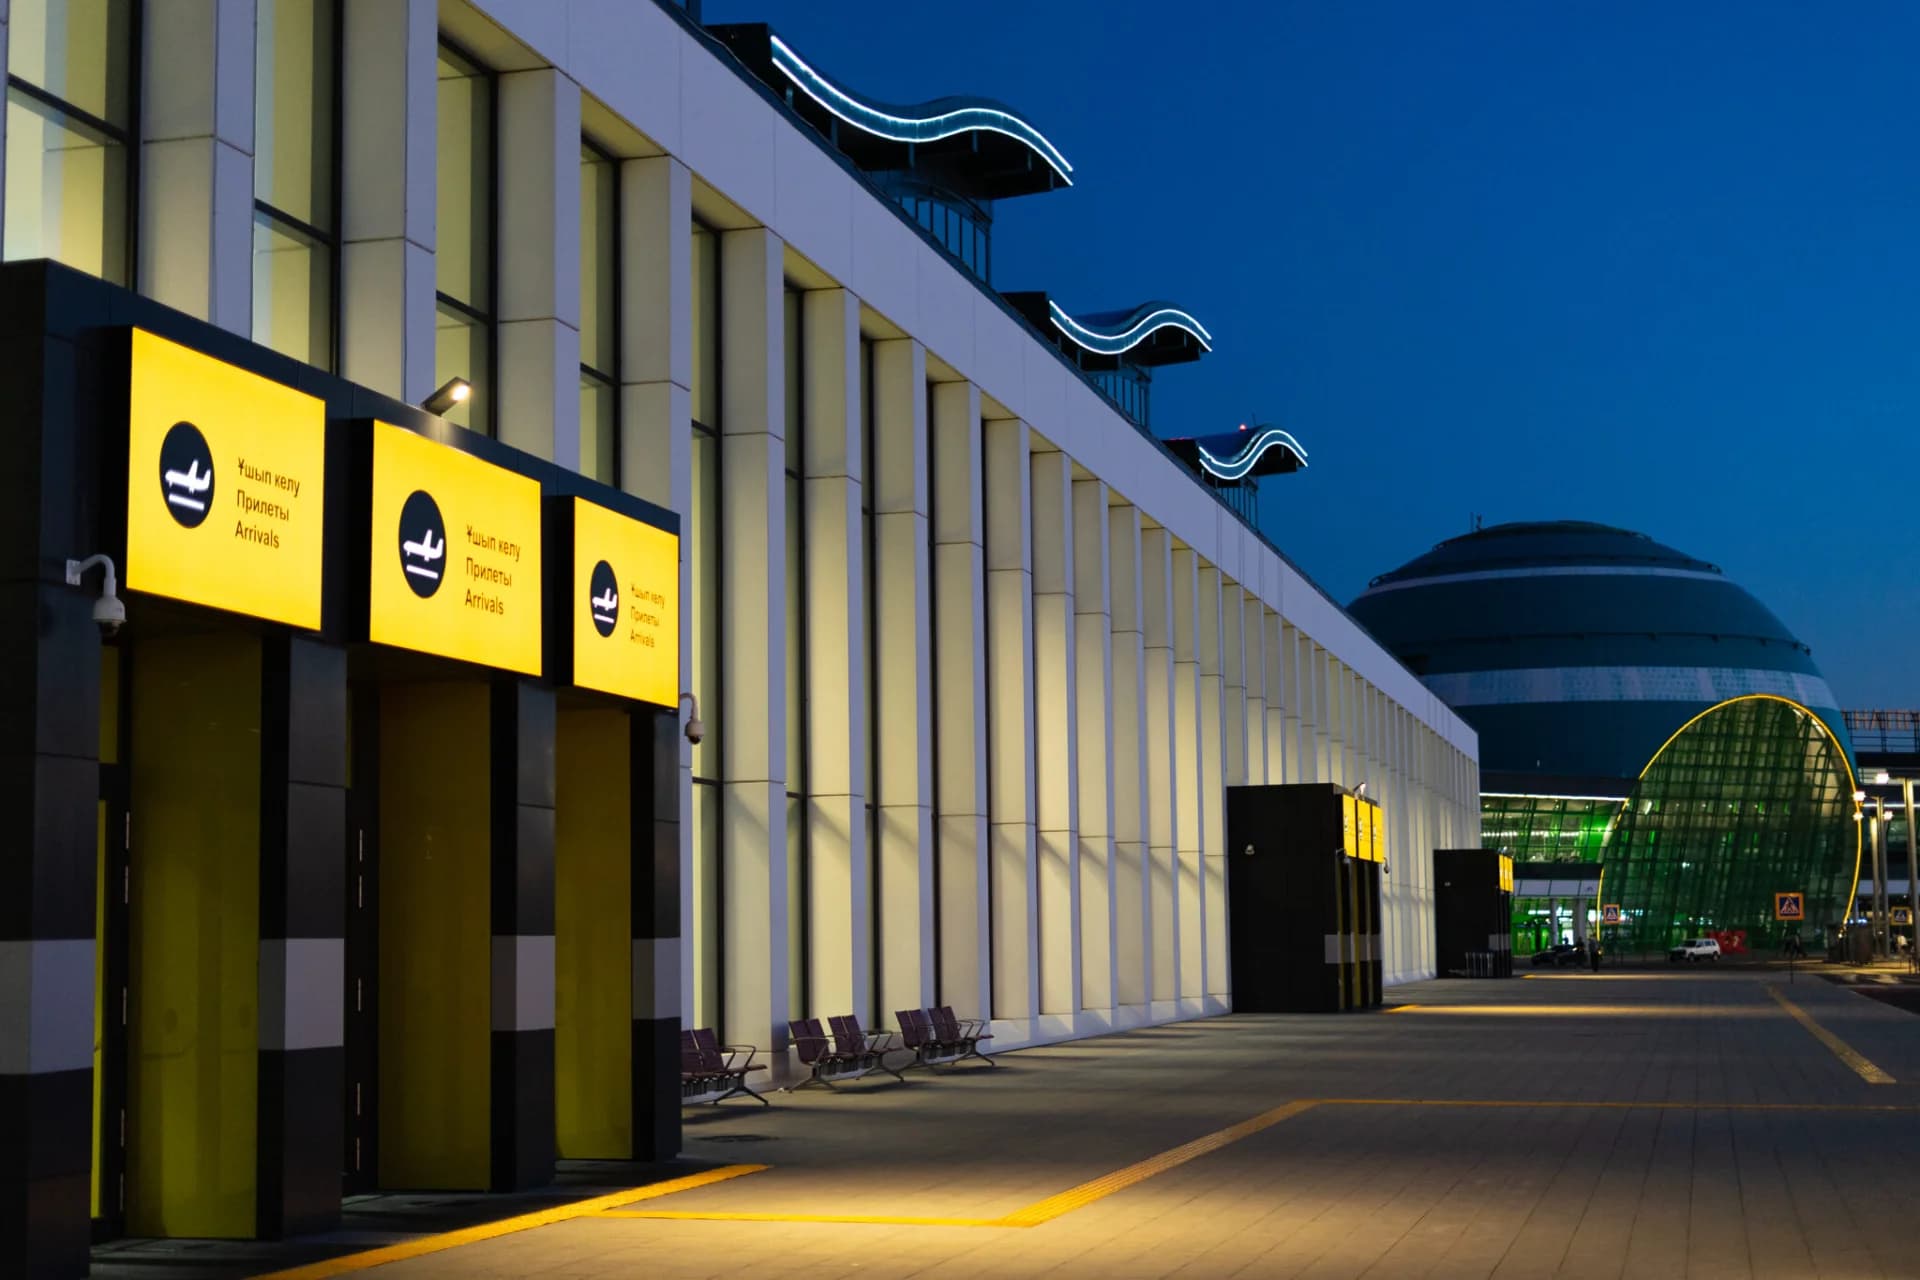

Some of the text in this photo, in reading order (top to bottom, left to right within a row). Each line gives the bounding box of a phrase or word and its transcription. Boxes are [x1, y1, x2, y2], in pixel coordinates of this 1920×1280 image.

[238, 457, 300, 498] Ұшып келу
[236, 489, 290, 521] Прилеты
[235, 520, 280, 549] Arrivals
[466, 524, 521, 562] Ұшып келу
[466, 556, 512, 587] Прилеты
[465, 588, 504, 615] Arrivals
